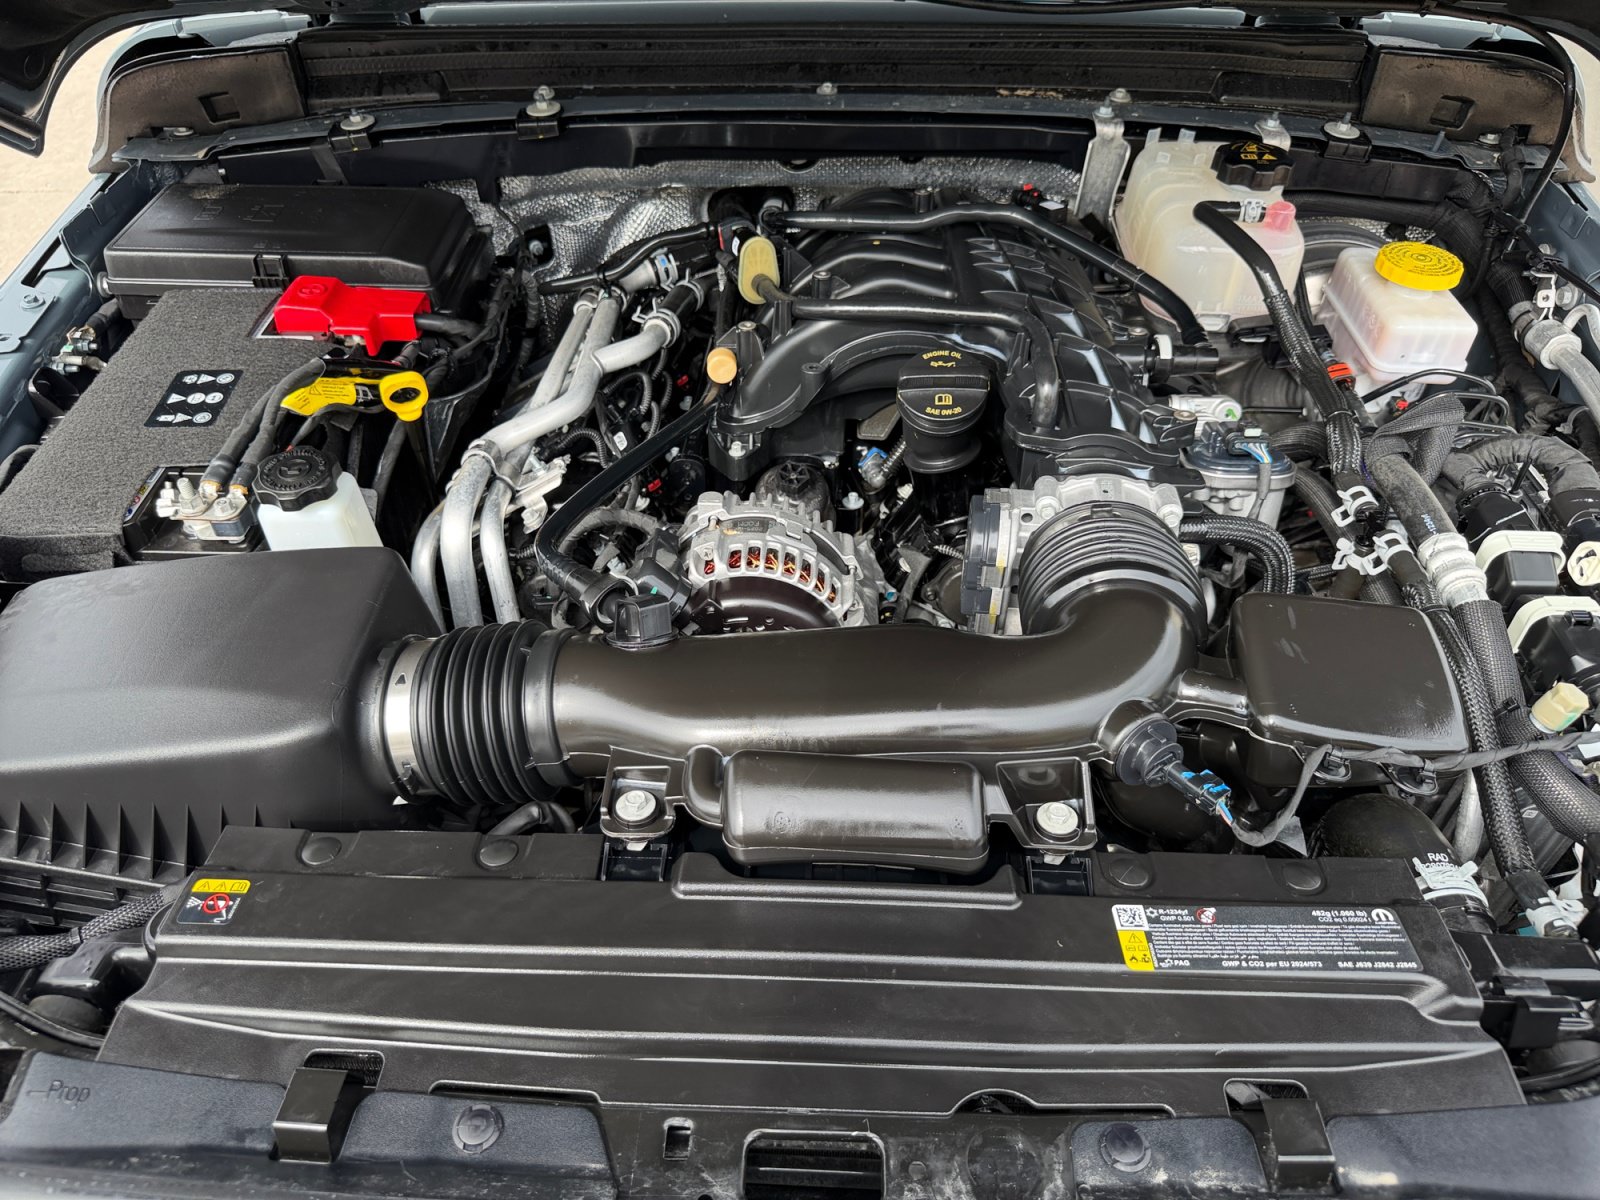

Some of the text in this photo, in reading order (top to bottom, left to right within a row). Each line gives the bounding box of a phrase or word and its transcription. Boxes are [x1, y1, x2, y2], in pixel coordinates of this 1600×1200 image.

[921, 350, 962, 360] ENGINE OIL
[925, 406, 962, 416] SAE 0W-20
[1427, 852, 1449, 862] RAD
[46, 1079, 91, 1106] Prop
